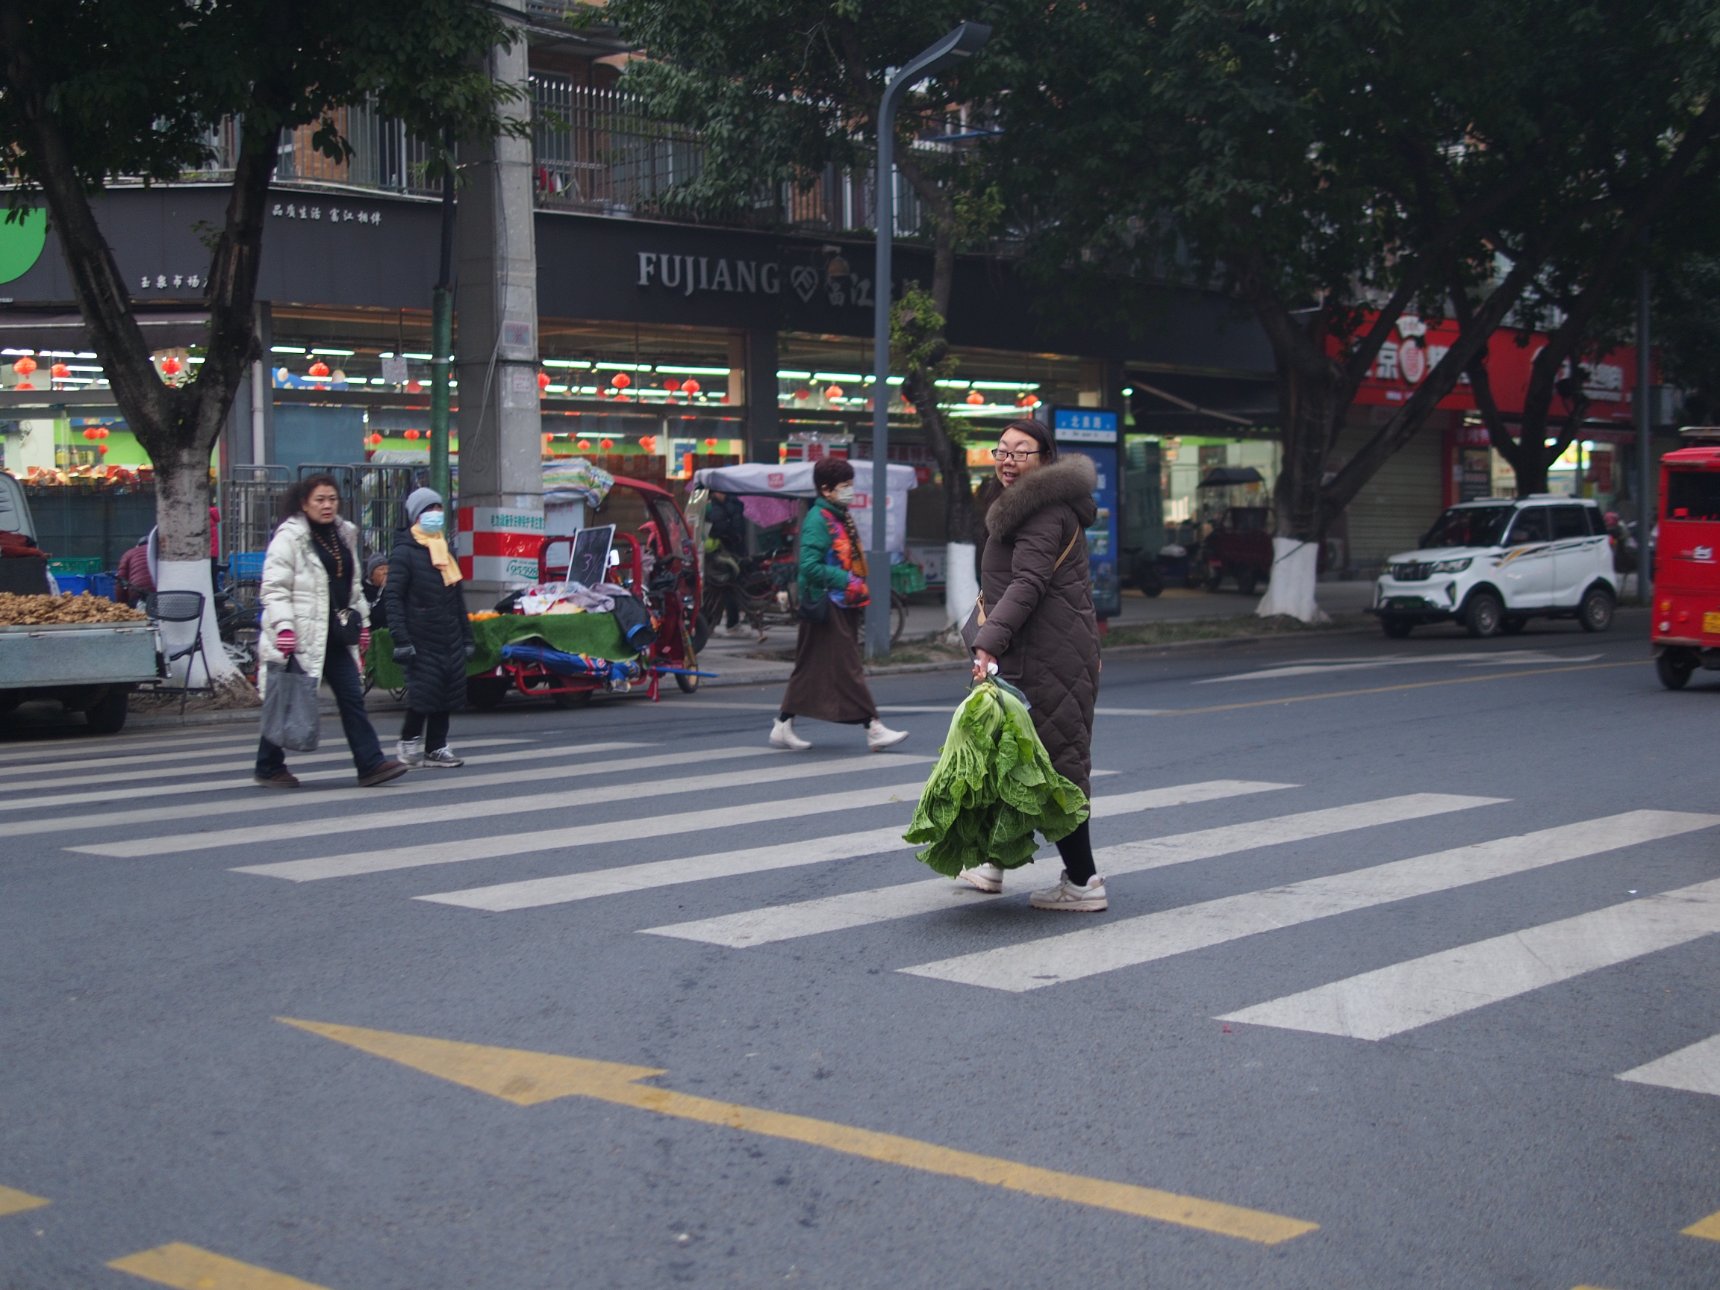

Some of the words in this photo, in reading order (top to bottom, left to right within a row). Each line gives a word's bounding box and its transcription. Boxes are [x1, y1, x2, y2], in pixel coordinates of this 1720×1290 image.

[141, 274, 209, 289] 玉泉市场
[637, 252, 781, 297] FUJIANG
